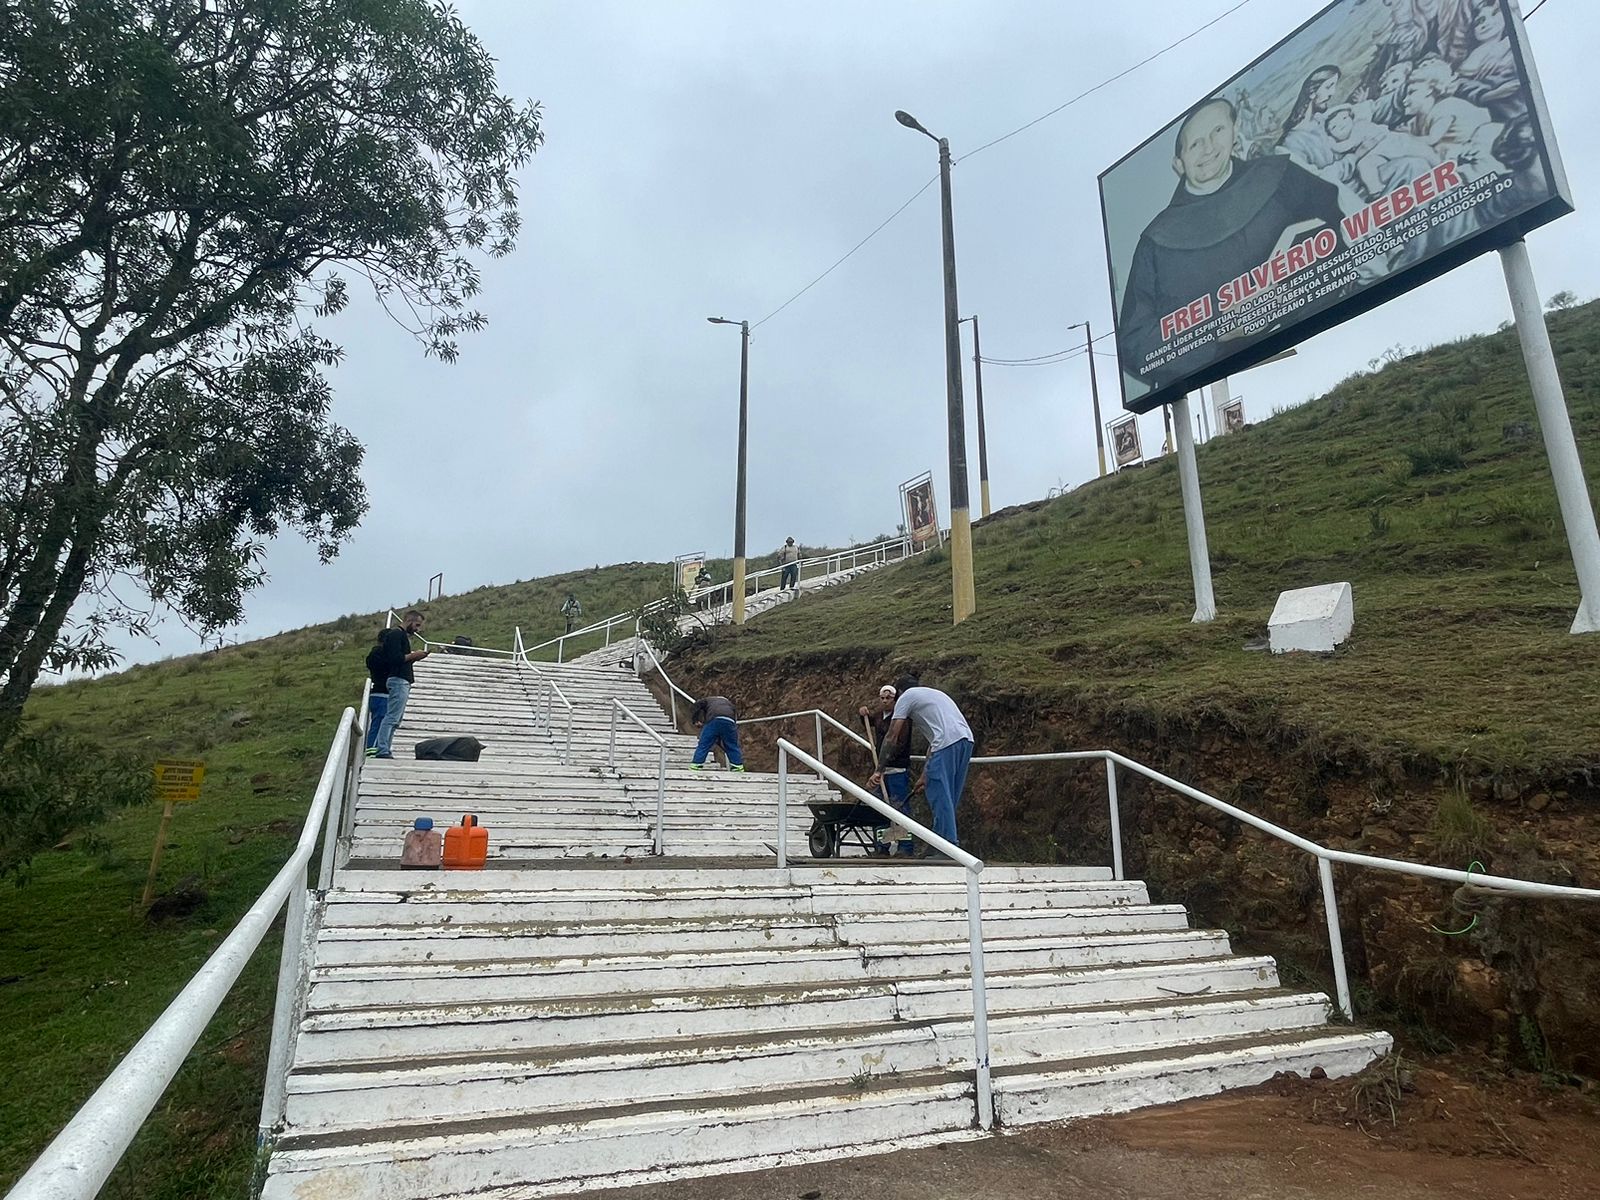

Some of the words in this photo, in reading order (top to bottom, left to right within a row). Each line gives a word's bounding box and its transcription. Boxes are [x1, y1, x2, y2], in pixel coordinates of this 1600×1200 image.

[1140, 359, 1165, 375] RAINHA
[1166, 352, 1177, 362] DO
[1178, 333, 1215, 356] UNIVERSO,
[1216, 320, 1236, 337] ESTÁ
[1237, 301, 1280, 327] PRESENTE,
[1282, 278, 1321, 304] ABENÇOA
[1322, 273, 1330, 283] E
[1331, 262, 1353, 278] VIVE
[1354, 249, 1375, 267] NOS
[1376, 224, 1429, 256] CORAÇÕES
[1431, 190, 1492, 226] BONDOSOS
[1495, 178, 1513, 194] DO
[1145, 343, 1172, 361] GRANDE
[1173, 331, 1194, 347] LÍDER
[1240, 303, 1252, 314] AO
[1254, 291, 1275, 308] LADO
[1276, 283, 1288, 295] DE
[1290, 270, 1315, 288] JESUS
[1316, 231, 1383, 274] RESSUSCITADO
[1385, 227, 1393, 239] E
[1394, 210, 1428, 233] MARIA
[1430, 172, 1498, 214] SANTÍSSIMA
[1160, 293, 1212, 341] FREI
[1217, 228, 1337, 311] SILVÉRIO
[1341, 160, 1462, 242] WEBER
[1243, 319, 1266, 335] POVO
[1268, 297, 1305, 323] LAGEANO
[1307, 293, 1314, 303] E
[1315, 271, 1359, 299] SERRANO.
